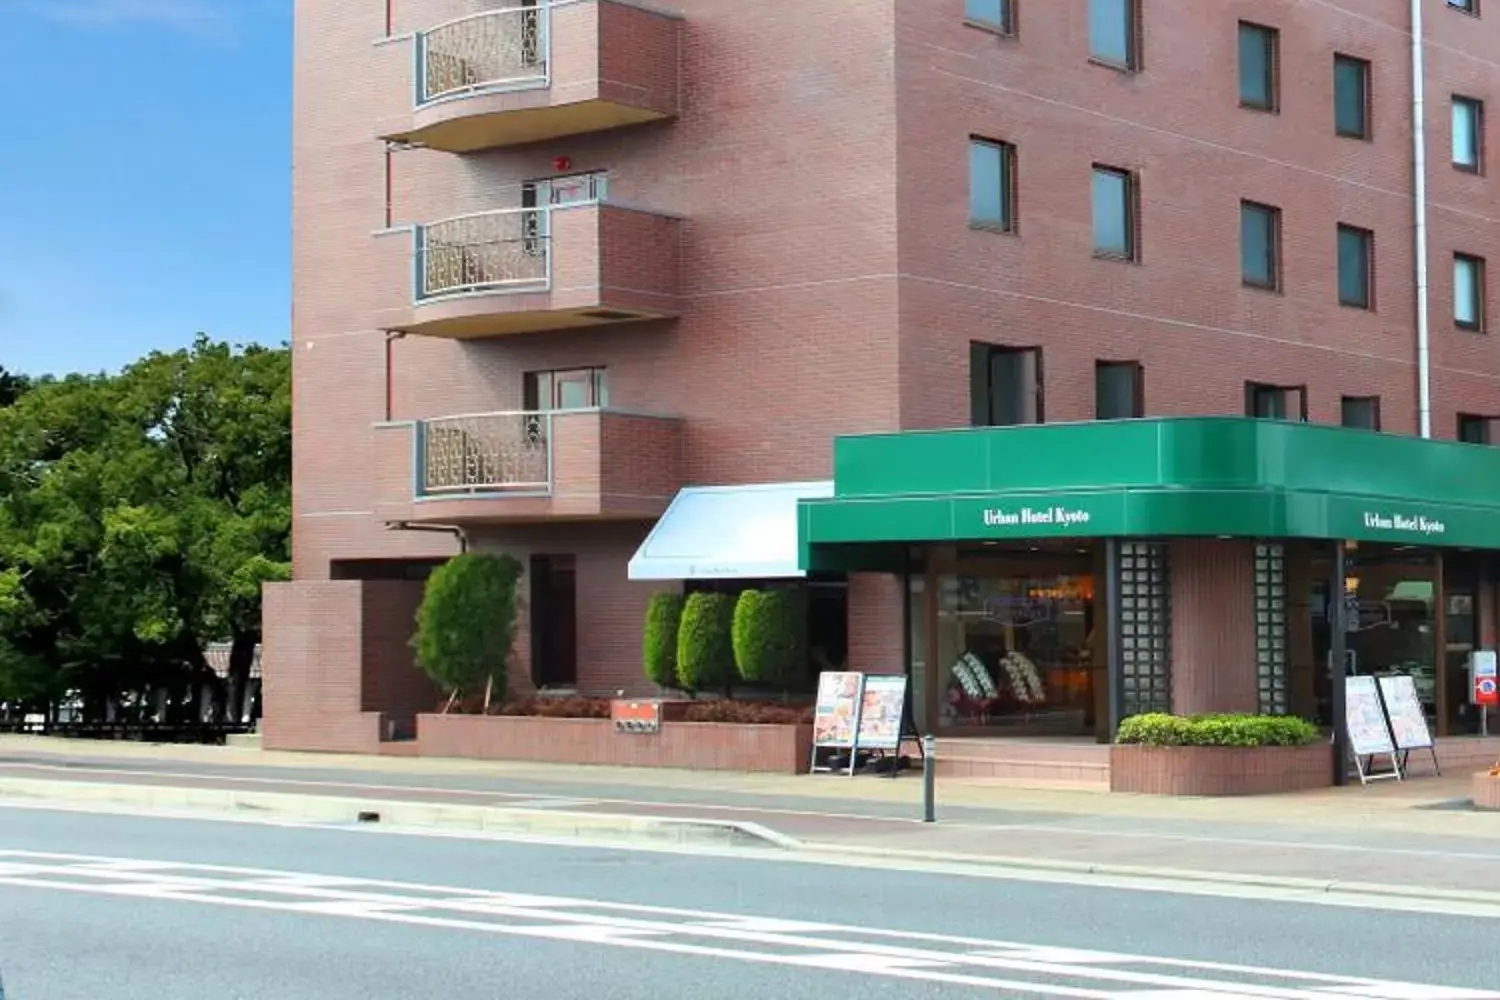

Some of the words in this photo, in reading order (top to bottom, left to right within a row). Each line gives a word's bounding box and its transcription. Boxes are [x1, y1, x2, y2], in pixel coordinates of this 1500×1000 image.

[983, 508, 1019, 525] Urban
[1021, 507, 1053, 523] Hotel
[1055, 506, 1090, 528] Kyoto
